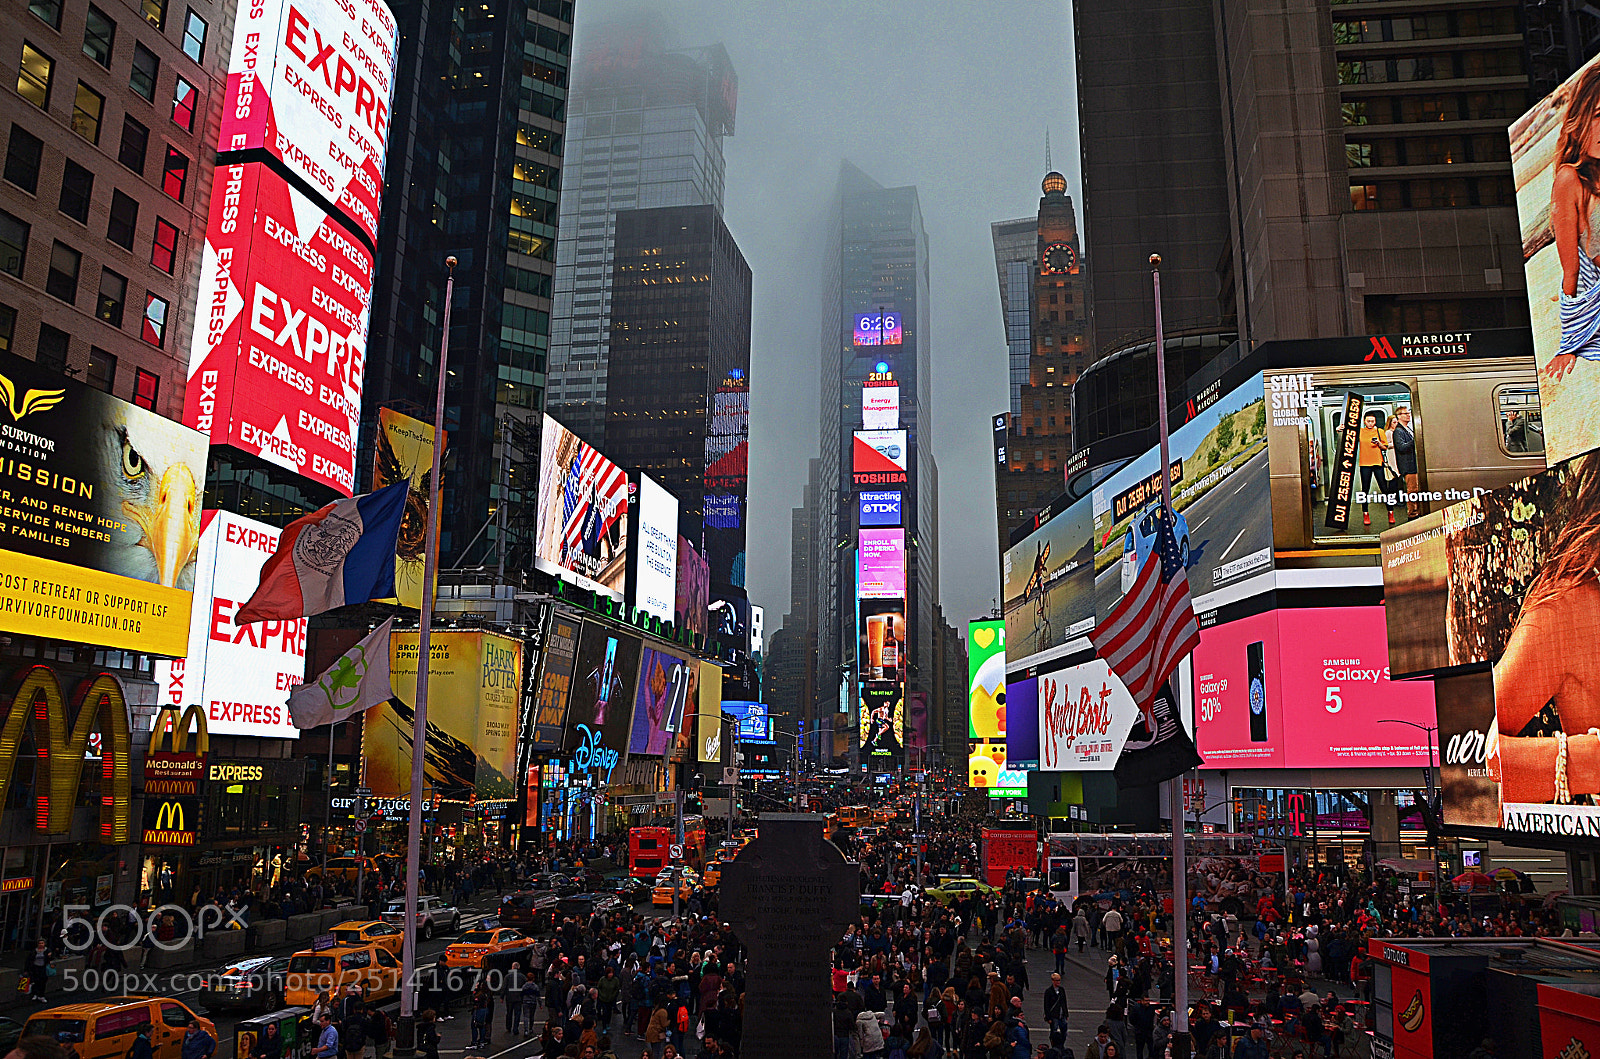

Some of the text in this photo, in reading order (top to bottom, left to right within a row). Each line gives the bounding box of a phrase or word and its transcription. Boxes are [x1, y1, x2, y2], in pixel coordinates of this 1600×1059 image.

[343, 31, 388, 93] EXPRESS
[235, 33, 260, 119] EXPRESS
[285, 64, 342, 129] EXPRESS
[277, 131, 335, 192] EXPRESS
[329, 141, 376, 198] EXPRESS
[264, 215, 327, 273] EXPRESS
[319, 222, 368, 275] EXPRESS
[208, 248, 233, 346] EXPRESS
[312, 286, 361, 336] EXPRESS
[860, 316, 895, 331] 6:26
[1402, 333, 1472, 345] MARRIOTT
[1403, 344, 1466, 357] MARQUIS
[248, 345, 314, 395] EXPRESS
[869, 372, 893, 381] 2018
[1196, 378, 1221, 403] MARRIOTT
[1270, 374, 1315, 392] STATE
[1197, 391, 1219, 413] MARQUIS
[1271, 391, 1324, 410] STREET
[1273, 410, 1300, 418] GLOBAL
[1273, 417, 1310, 426] ADVISORS
[2, 424, 55, 452] SURVIVOR
[298, 409, 351, 453] EXPRESS
[241, 421, 307, 466] EXPRESS
[1067, 447, 1091, 466] MARRIOTT
[1068, 459, 1088, 475] MARQUIS
[853, 474, 907, 484] TOSHIBA
[1181, 489, 1195, 500] Bring
[1194, 476, 1209, 494] home
[1209, 472, 1219, 484] the
[871, 503, 899, 513] TDK
[1355, 486, 1471, 506] Bring home the
[20, 496, 128, 532] AND RENEW HOPE
[1334, 504, 1347, 522] DJI
[12, 525, 70, 547] FAMILIES
[55, 520, 111, 543] MEMBERS
[1386, 527, 1441, 555] NO RETOUCHING ON
[1213, 567, 1222, 580] DIA
[32, 578, 81, 601] RETREAT
[86, 590, 99, 605] OR
[103, 593, 149, 615] SUPPORT
[151, 604, 168, 618] LSF
[592, 592, 639, 625] 1540
[485, 642, 518, 672] HARRY
[482, 664, 518, 692] POTTER
[543, 672, 570, 692] COME
[1200, 679, 1228, 695] Galaxy S9
[1323, 667, 1382, 684] Galaxy
[1201, 696, 1222, 722] 50%
[1325, 686, 1343, 714] 5
[209, 700, 281, 725] EXPRESS
[537, 706, 565, 726] AWAY
[1044, 677, 1113, 769] Kinky Boots
[146, 759, 203, 770] McDonald's
[154, 769, 193, 777] Restaurant
[209, 765, 263, 781] EXPRESS
[1506, 812, 1600, 838] AMERICAN
[746, 885, 787, 894] FRANCIS
[799, 885, 832, 894] DUFFY
